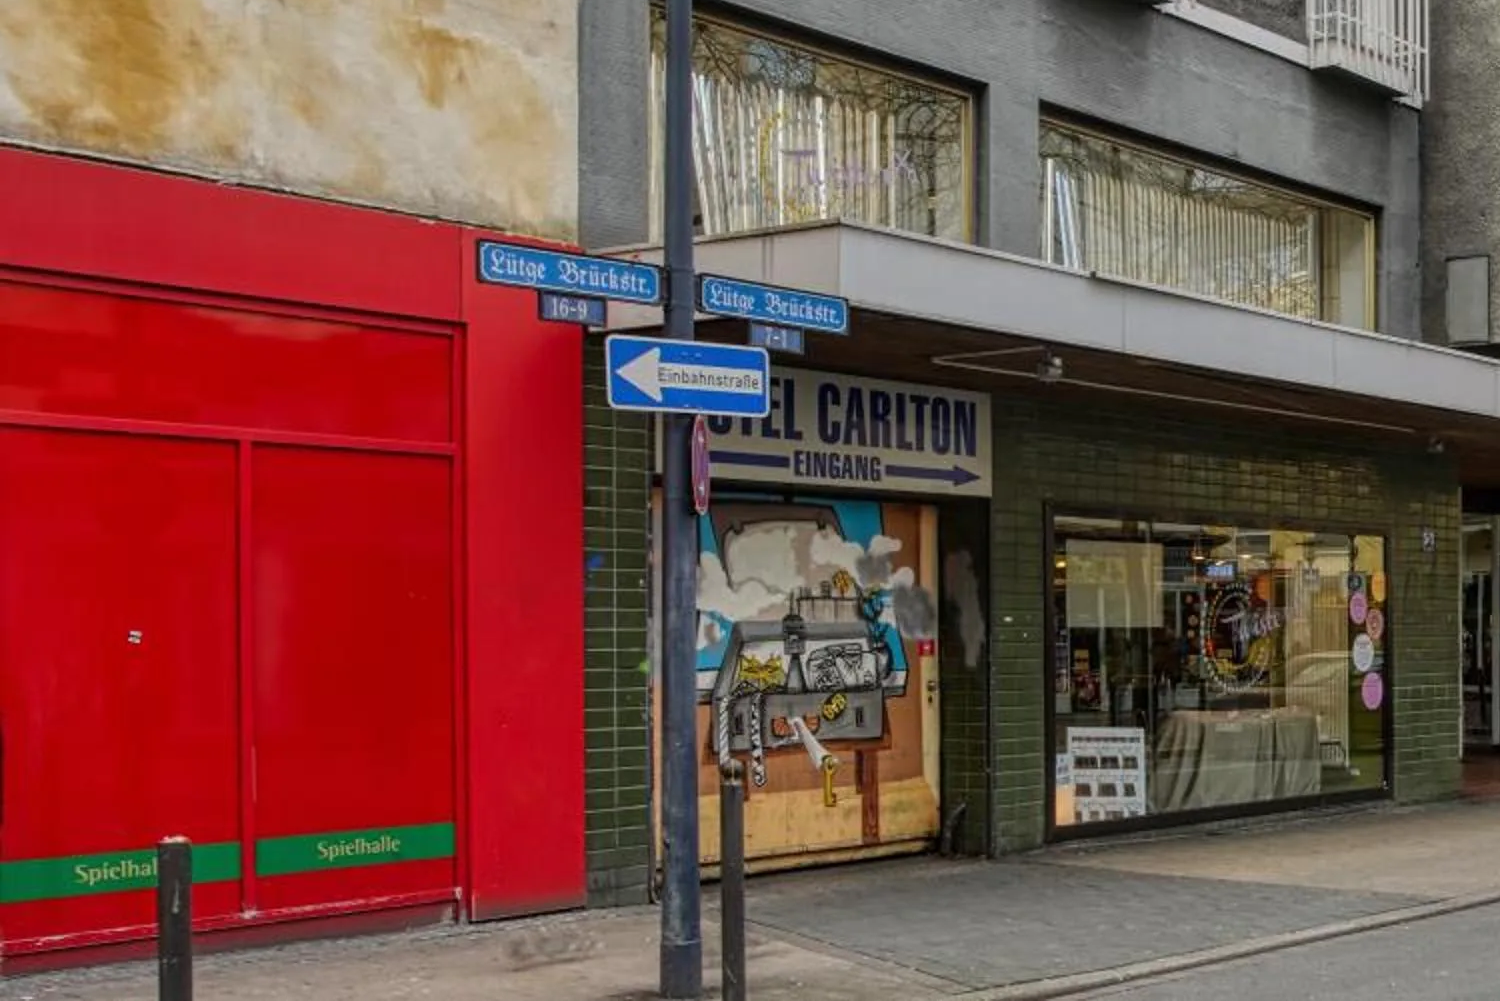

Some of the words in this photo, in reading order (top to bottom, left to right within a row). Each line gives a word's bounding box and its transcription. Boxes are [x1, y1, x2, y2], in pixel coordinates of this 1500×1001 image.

[490, 248, 546, 284] Lütge
[558, 258, 652, 296] Brückstr.
[551, 297, 588, 319] 16-9
[657, 366, 760, 390] Einbahnstraße
[817, 382, 977, 457] CARLTON
[793, 450, 882, 482] EINGANG
[316, 835, 401, 862] Spielhalle
[74, 856, 158, 886] Spielhal
